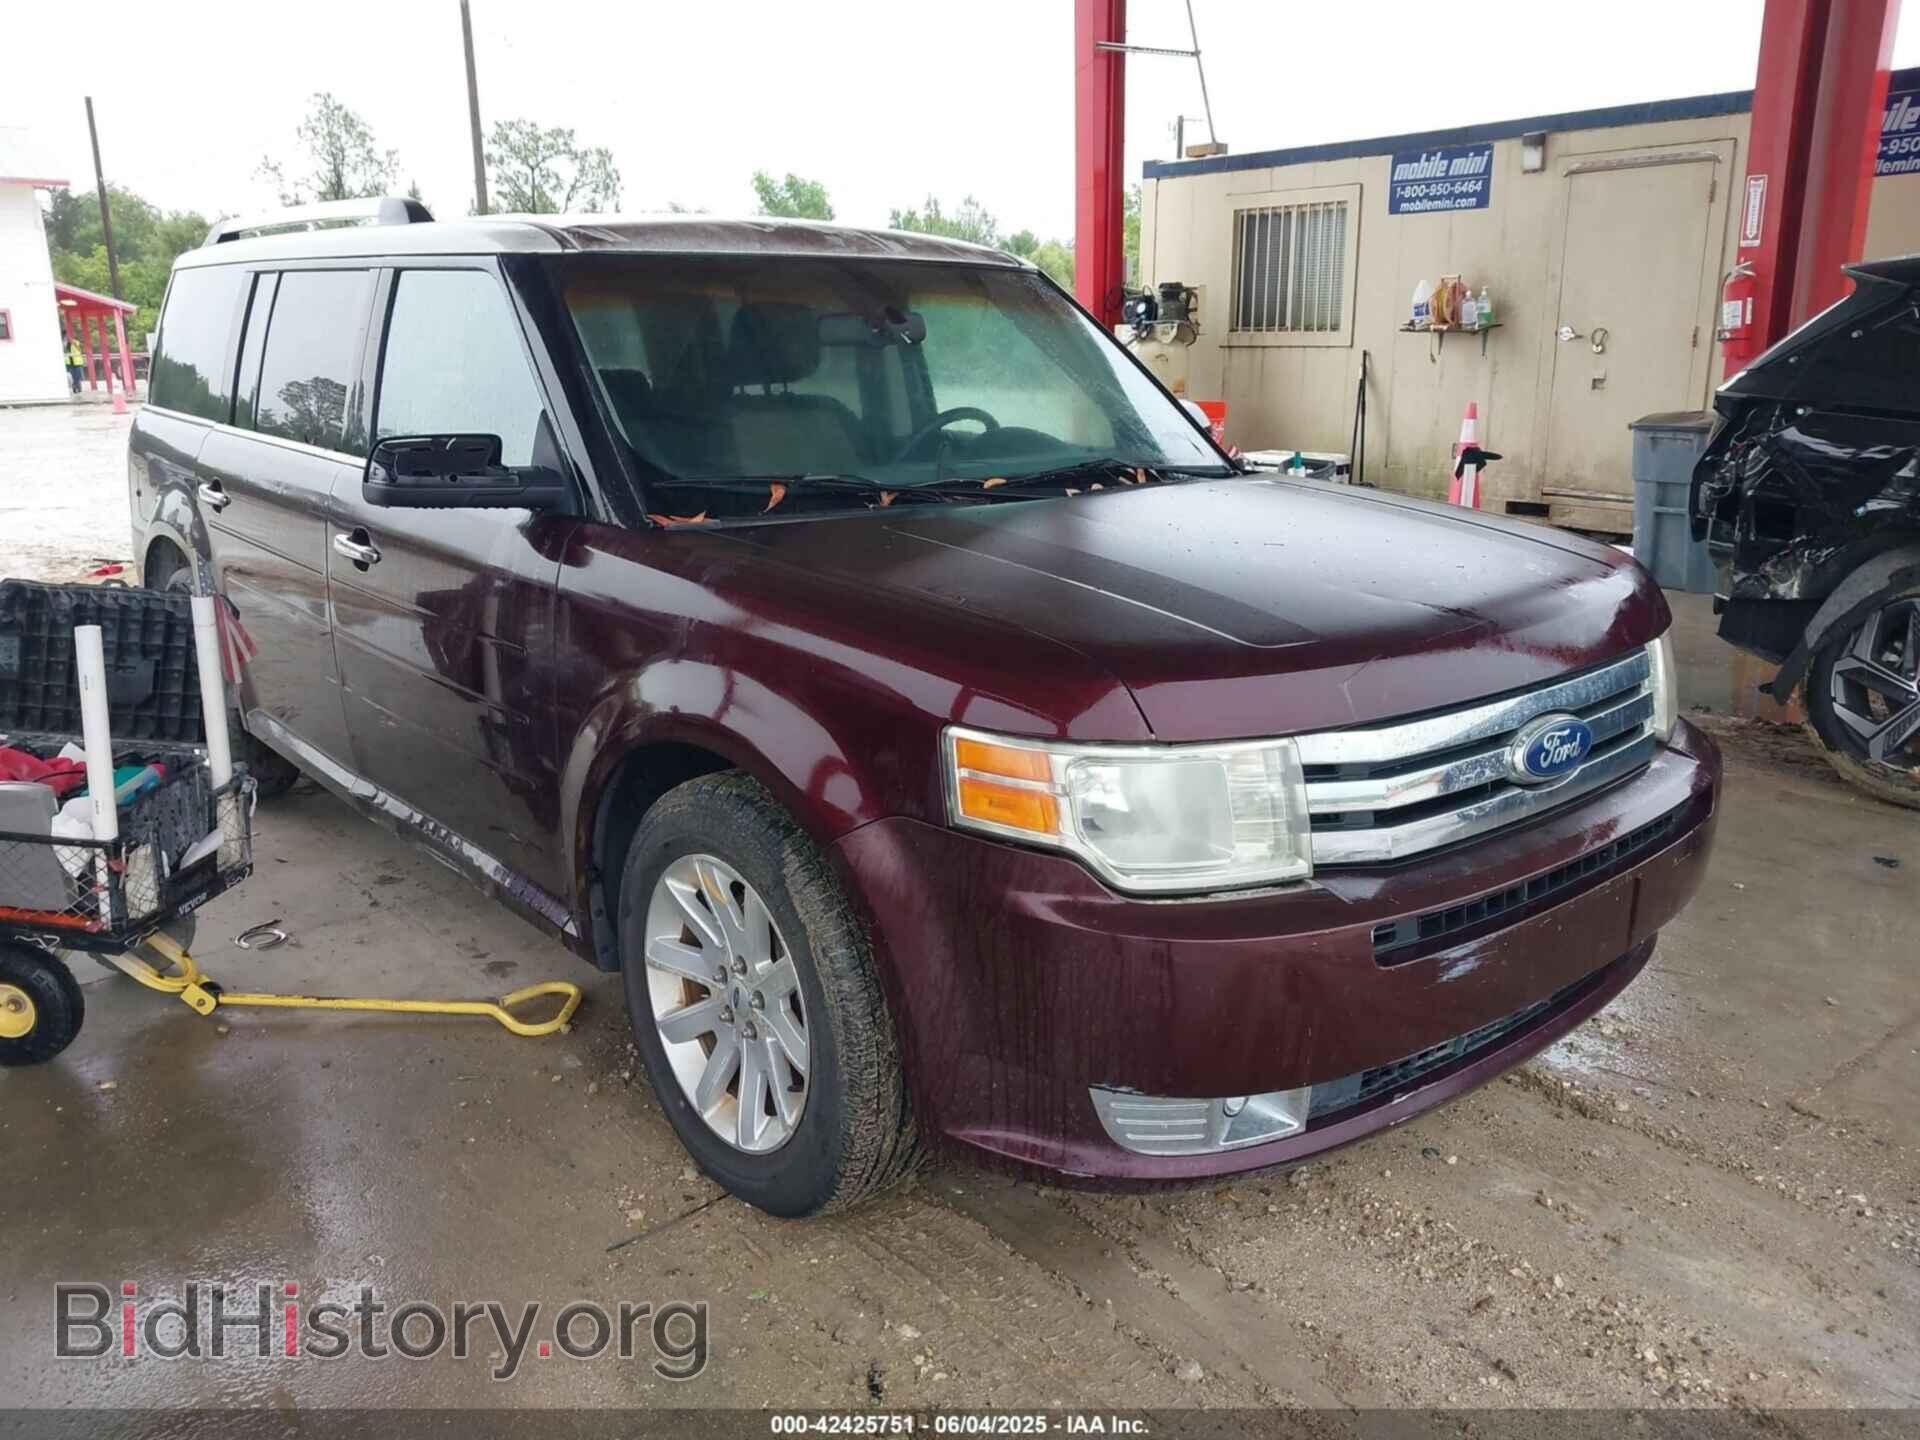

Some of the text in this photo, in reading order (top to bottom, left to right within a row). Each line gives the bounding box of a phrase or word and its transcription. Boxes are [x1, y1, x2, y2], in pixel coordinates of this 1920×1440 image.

[1393, 150, 1491, 180] mobile mini
[1396, 180, 1483, 198] 1-800-950-6464
[1400, 197, 1477, 212] mobilemini.com
[1540, 728, 1581, 768] Ford
